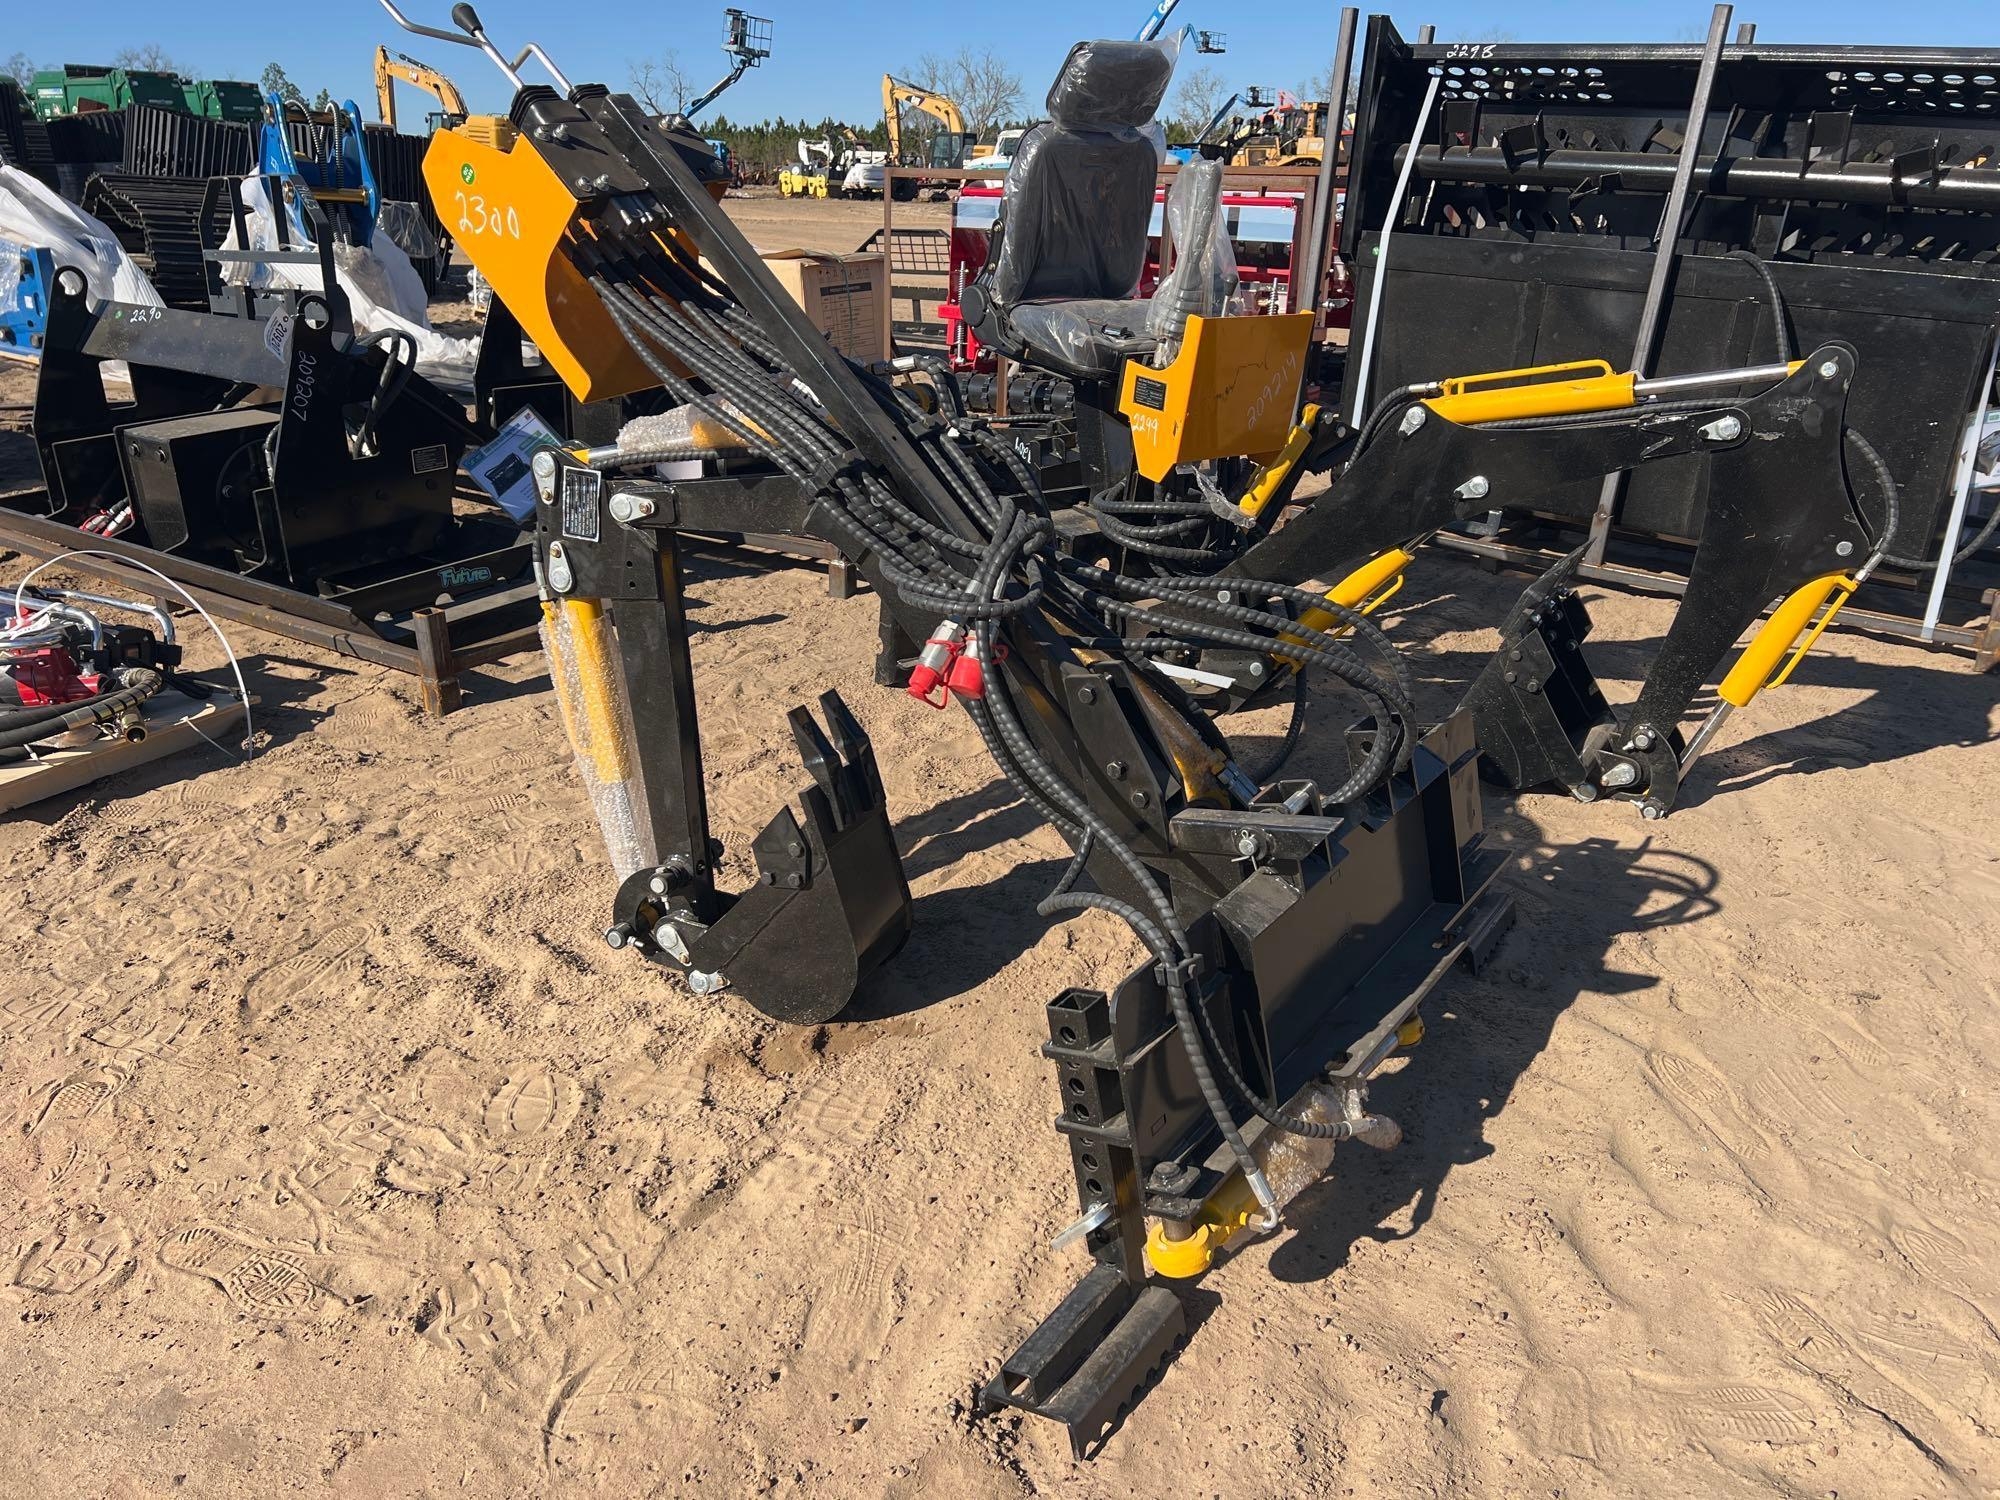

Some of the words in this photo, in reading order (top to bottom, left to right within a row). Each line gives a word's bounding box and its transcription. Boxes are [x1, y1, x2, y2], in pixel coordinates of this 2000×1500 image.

[1446, 44, 1497, 59] 2298
[455, 189, 519, 240] 2300
[130, 306, 162, 323] 2290
[291, 350, 317, 422] 209207
[1131, 412, 1159, 447] 2299
[438, 566, 492, 588] Future
